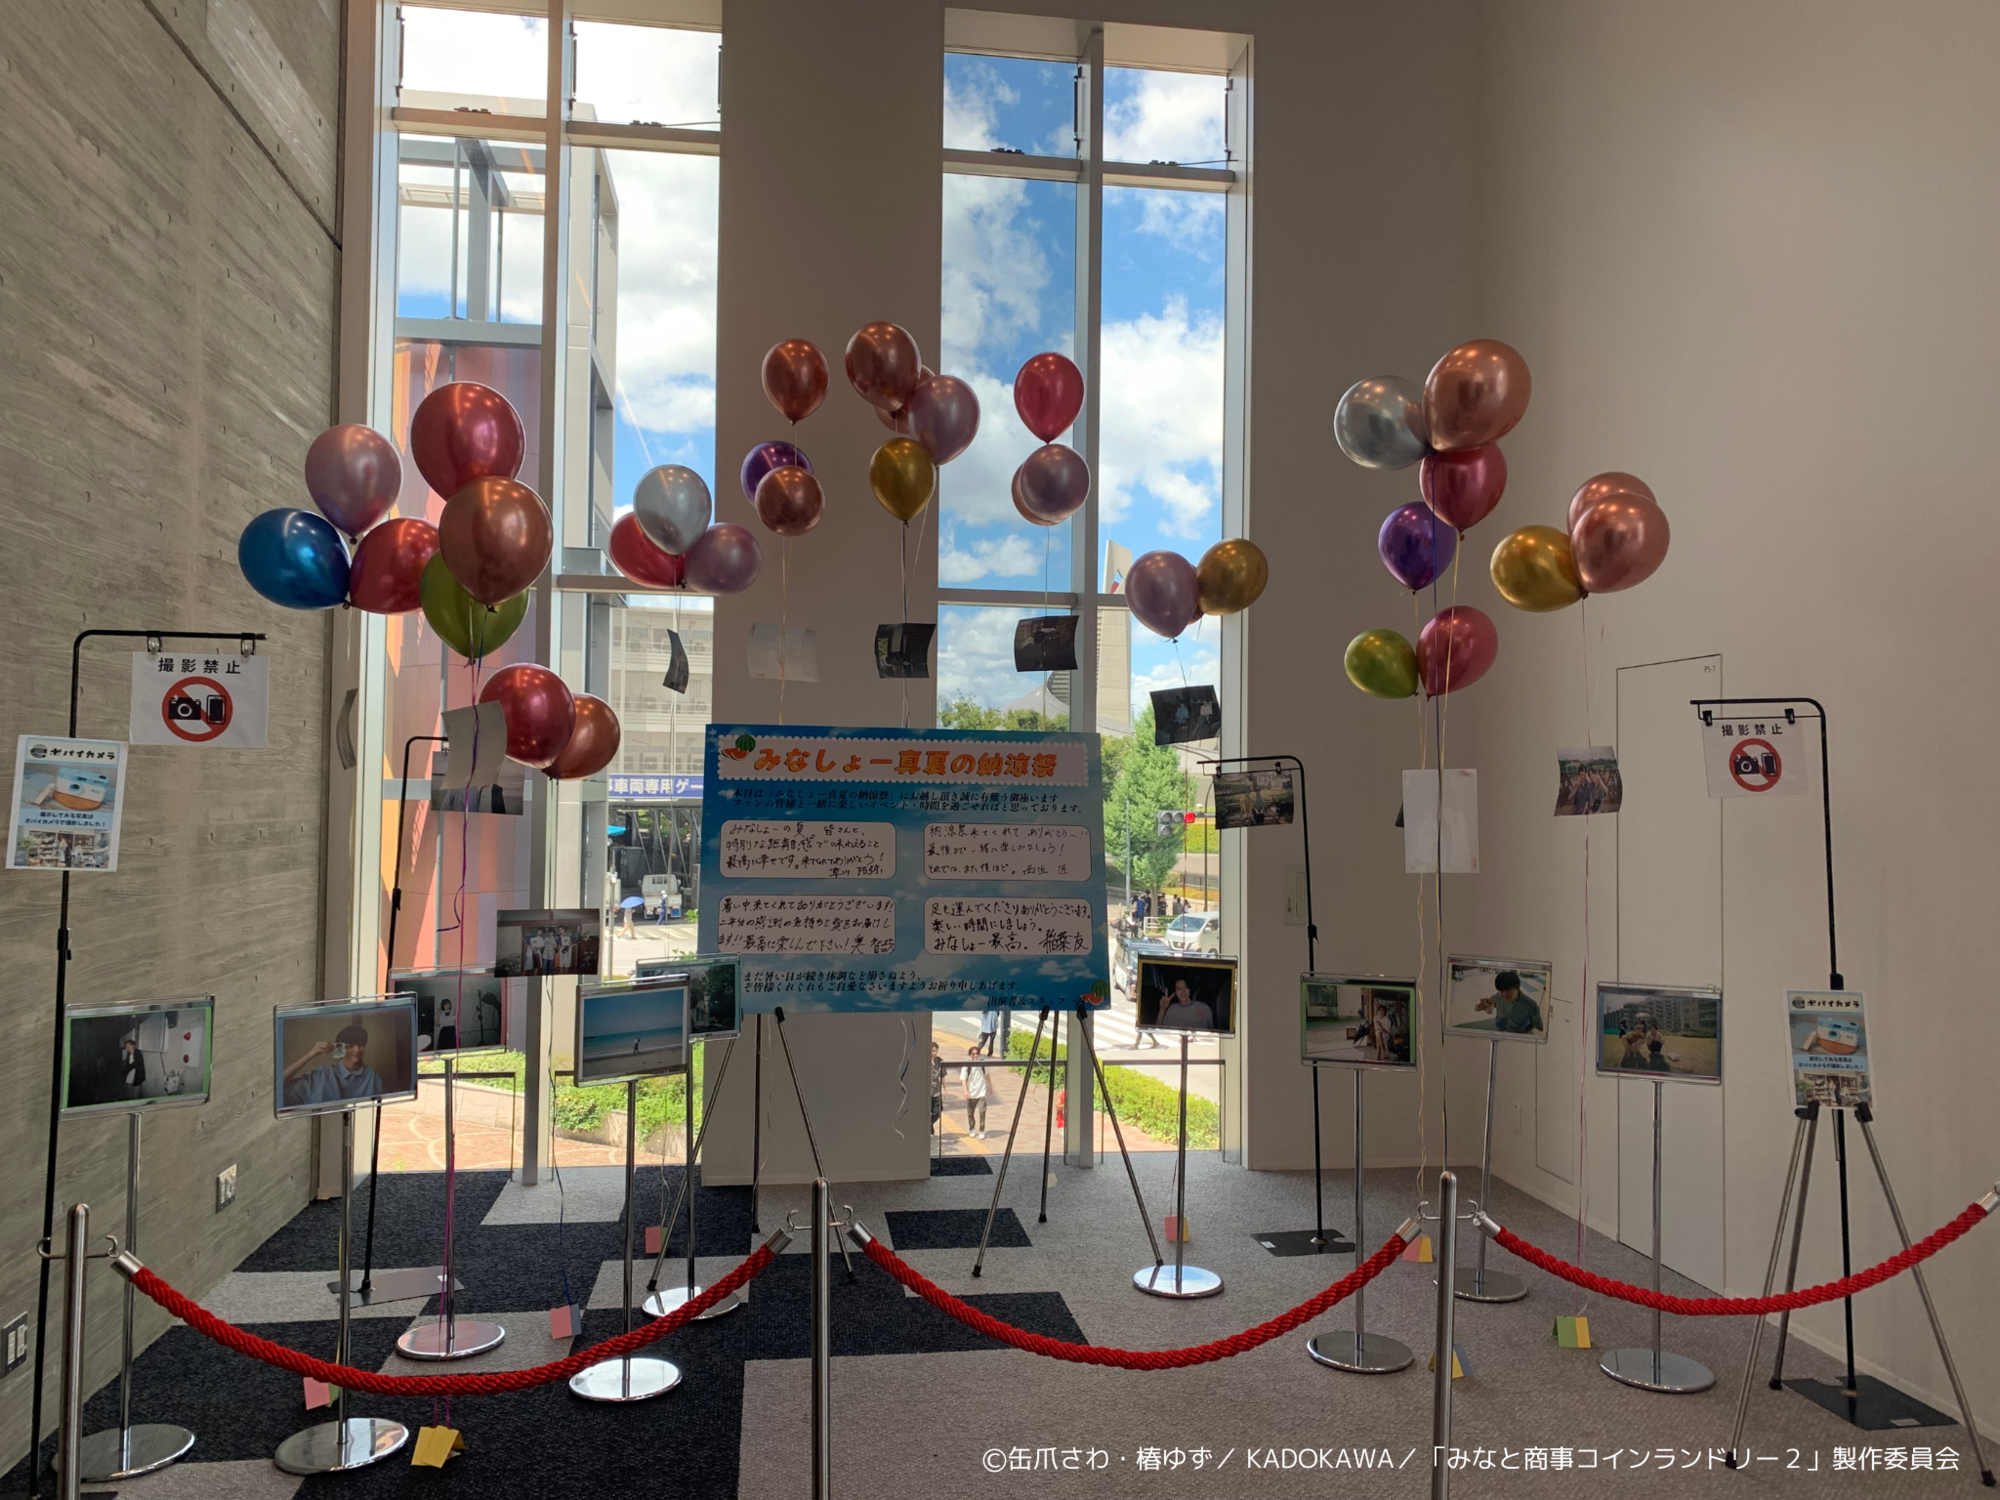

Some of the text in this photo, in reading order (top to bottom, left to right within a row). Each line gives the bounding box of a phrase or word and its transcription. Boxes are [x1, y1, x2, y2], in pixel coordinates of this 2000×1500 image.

[158, 657, 241, 674] 撮影禁止
[1721, 723, 1783, 737] 撮影禁止
[754, 748, 1057, 778] みなしょー真夏の納涼祭
[733, 787, 1059, 803] 本日は「みなしょー真夏の納涼祭」にお越し頂き誠に有難う御座います
[733, 799, 1082, 813] ファンの皆様と一緒に楽しいイベント・時間を過ごせればと思っております。
[931, 917, 1043, 933] 楽しい時間にしましょう。
[740, 971, 922, 982] まだ暑い日が続き体調など崩さぬよう、
